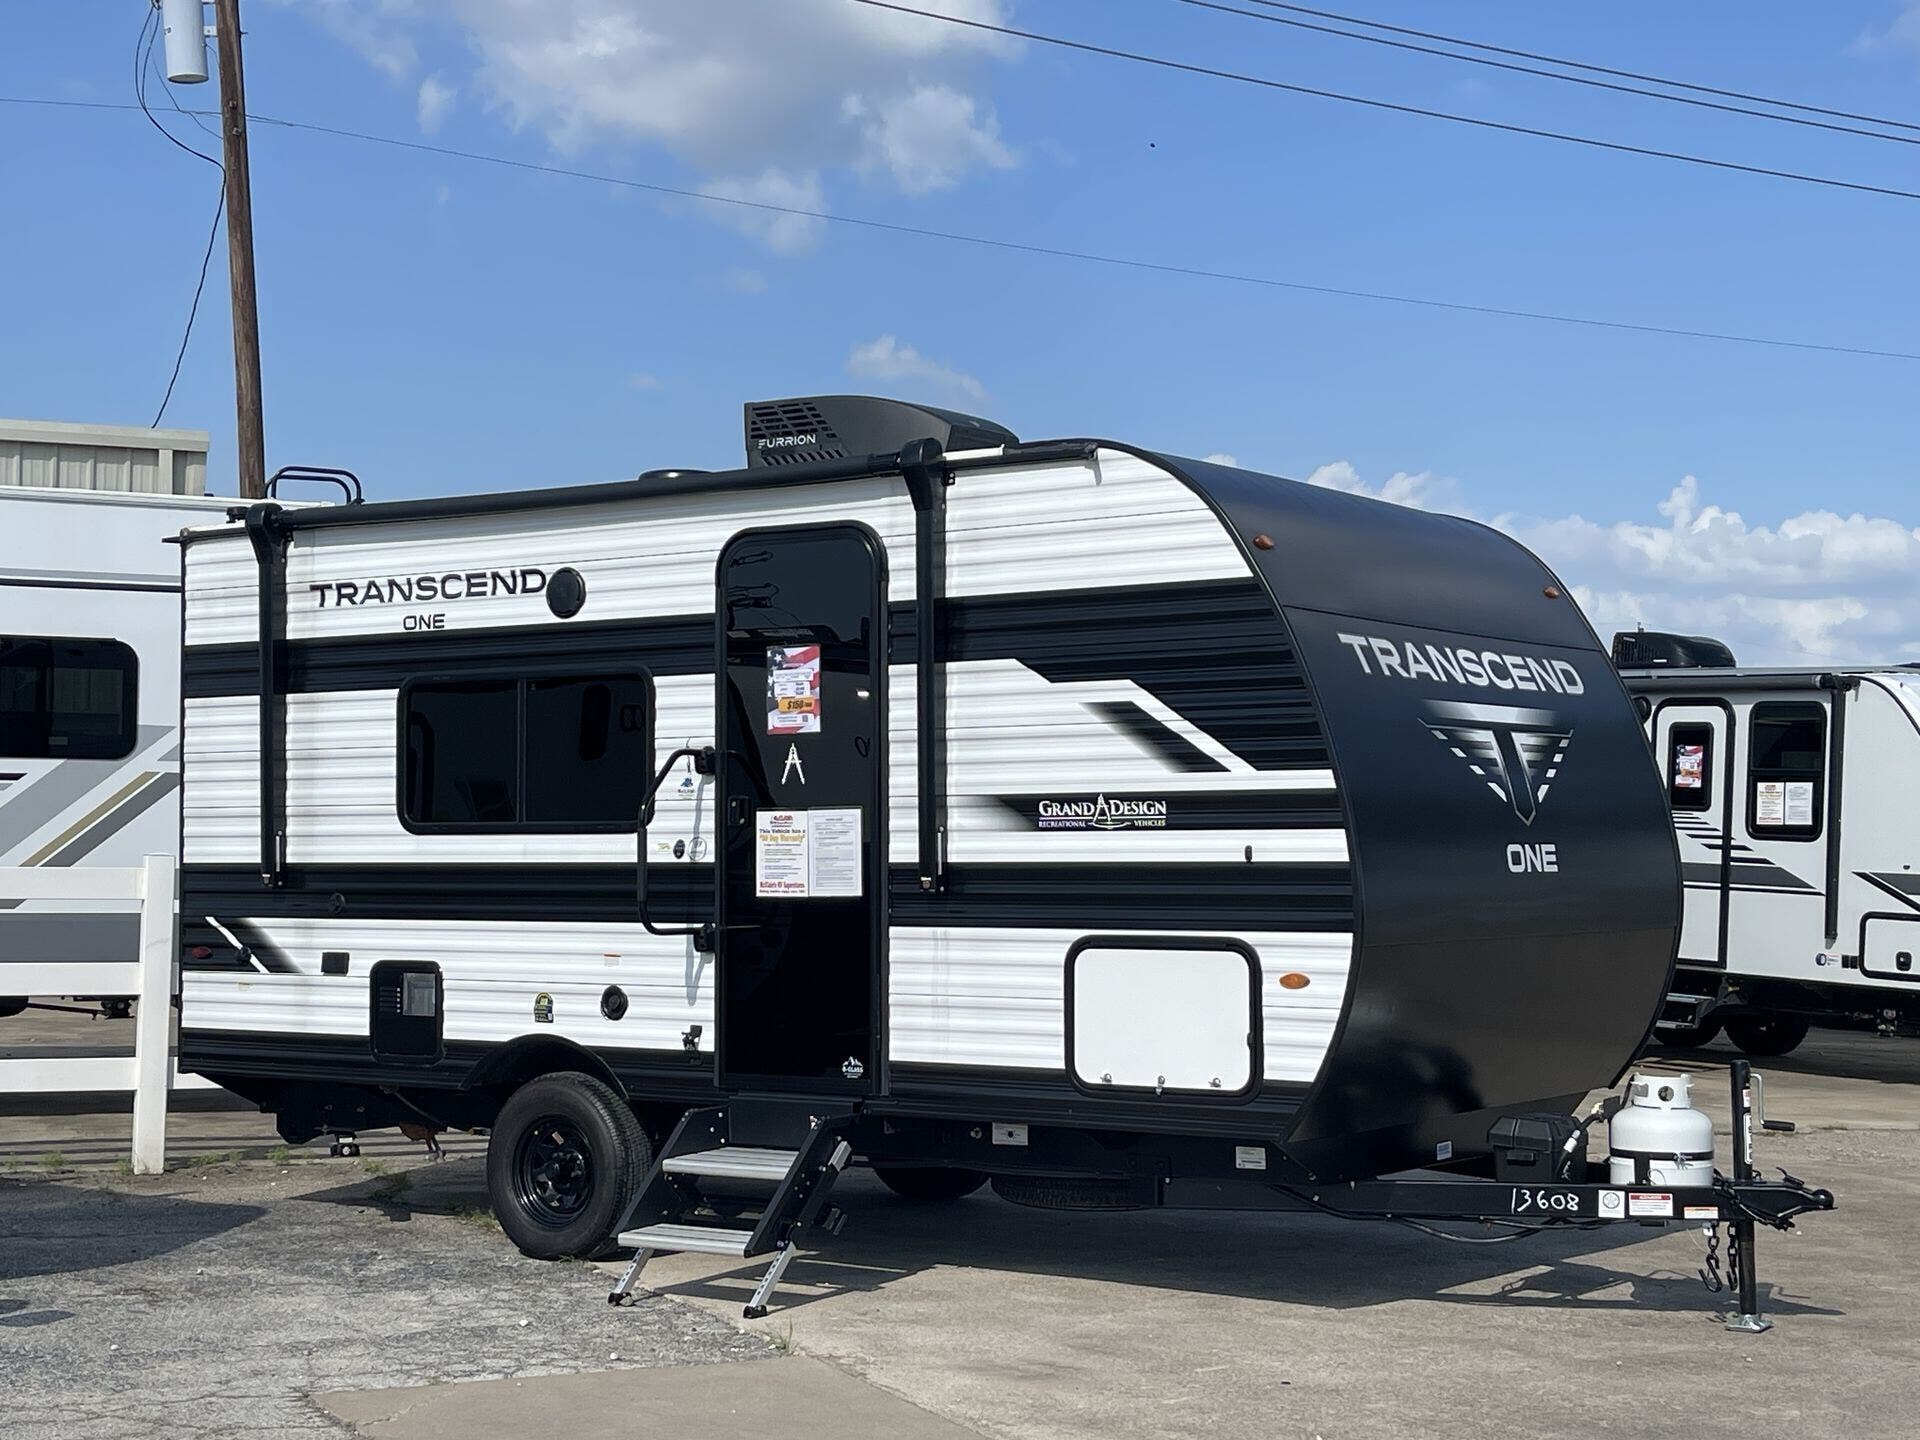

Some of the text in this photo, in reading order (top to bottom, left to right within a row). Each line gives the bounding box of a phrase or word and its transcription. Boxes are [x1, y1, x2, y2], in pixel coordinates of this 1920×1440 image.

[757, 433, 816, 449] FURRION
[309, 568, 547, 608] TRANSCEND
[403, 613, 446, 631] ONE
[1336, 632, 1585, 695] TRANSCEND
[1038, 799, 1167, 816] GRAND DESIGN
[1038, 819, 1166, 828] RECREATIONAL VEHICLES
[1506, 843, 1559, 873] ONE
[1511, 1187, 1580, 1215] 13608
